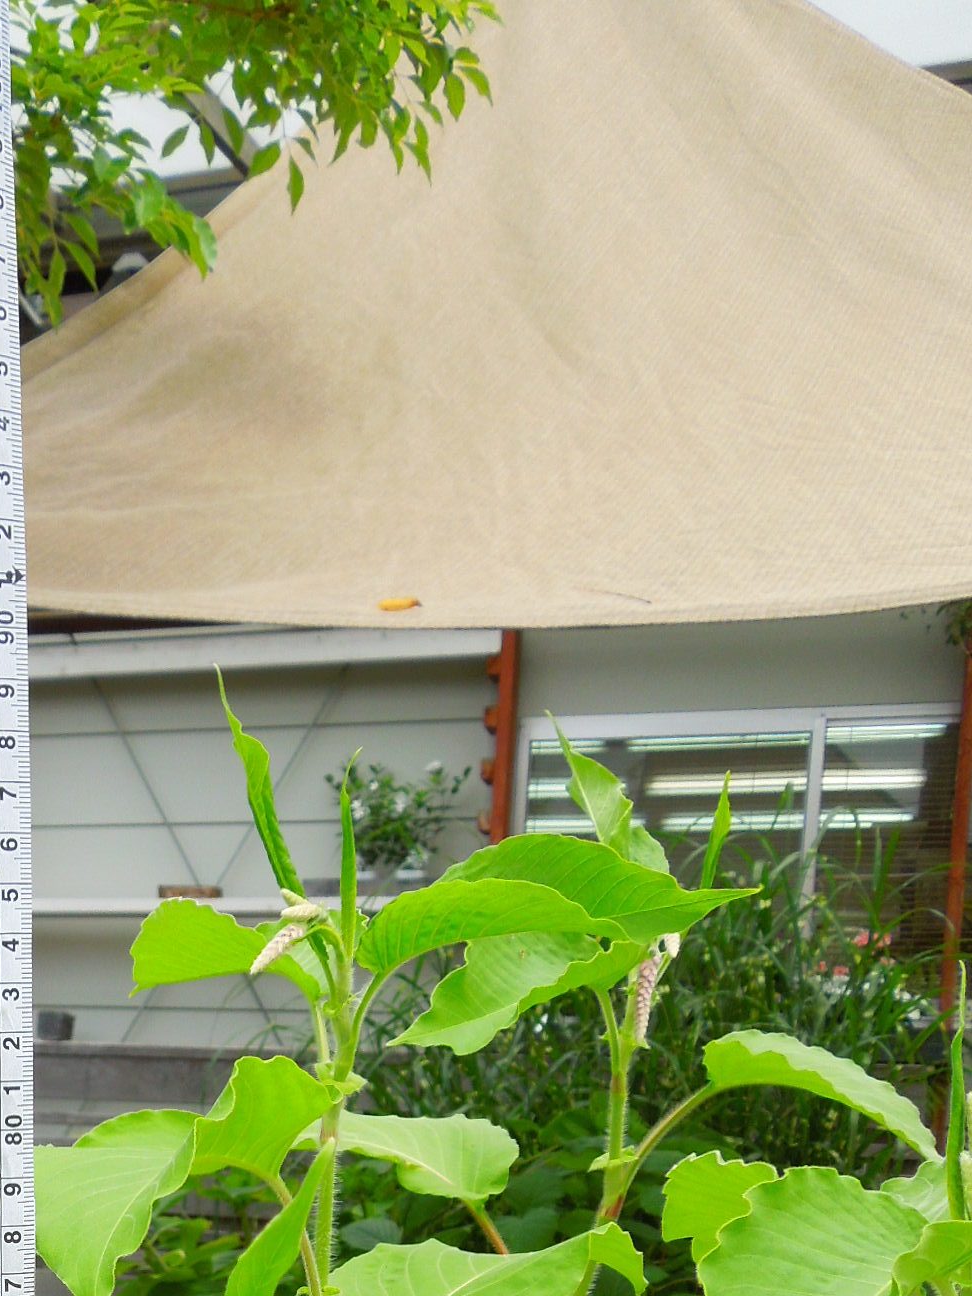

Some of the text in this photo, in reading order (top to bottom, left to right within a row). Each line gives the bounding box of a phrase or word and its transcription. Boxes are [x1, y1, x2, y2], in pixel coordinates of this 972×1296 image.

[0, 787, 17, 801] 7
[0, 838, 18, 851] 6
[2, 888, 19, 902] 5
[2, 938, 19, 952] 4
[2, 988, 20, 1001] 3
[3, 1036, 20, 1050] 2
[3, 1085, 21, 1095] 1
[5, 1115, 22, 1145] 80
[4, 1183, 21, 1196] 9
[4, 1230, 21, 1244] 8
[5, 1279, 21, 1292] 7
